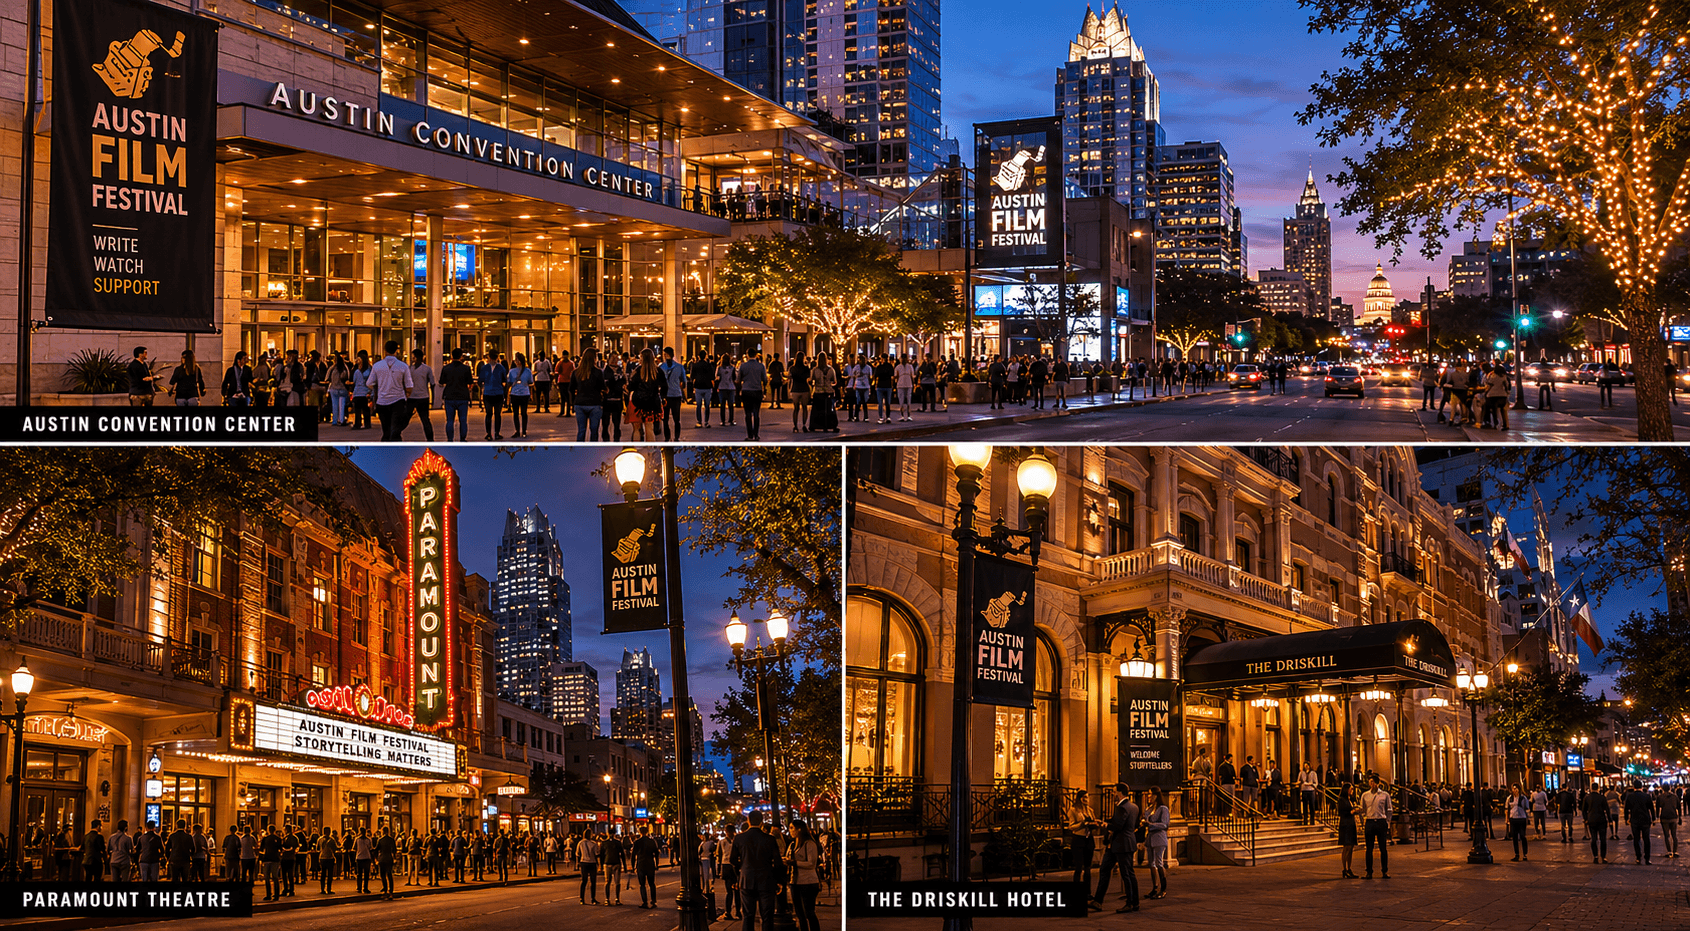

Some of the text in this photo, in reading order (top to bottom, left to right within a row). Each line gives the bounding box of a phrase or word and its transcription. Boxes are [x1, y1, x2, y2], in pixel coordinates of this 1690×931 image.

[92, 102, 186, 142] AUSTIN
[270, 83, 652, 200] AUSTIN CONVENTION CENTER
[92, 134, 187, 188] FILM
[92, 184, 188, 216] FESTIVAL
[992, 193, 1045, 210] AUSTIN
[992, 209, 1046, 232] FILM
[93, 235, 138, 253] WRITE
[992, 232, 1046, 246] FESTIVAL
[93, 256, 144, 274] WATCH
[93, 278, 160, 296] SUPPORT
[612, 564, 657, 579] AUSTIN
[612, 577, 658, 598] FILM
[419, 486, 440, 710] PARAMOUNT
[612, 597, 660, 610] FESTIVAL
[979, 630, 1024, 648] AUSTIN
[978, 644, 1023, 670] FILM
[1246, 655, 1337, 674] THE DRISKILL
[978, 667, 1024, 684] FESTIVAL
[1130, 699, 1168, 711] AUSTIN
[1130, 712, 1168, 728] FILM
[300, 719, 429, 753] AUSTIN FILM FESTIVAL
[1130, 729, 1169, 738] FESTIVAL
[295, 736, 432, 767] STORYTELLING MATTERS
